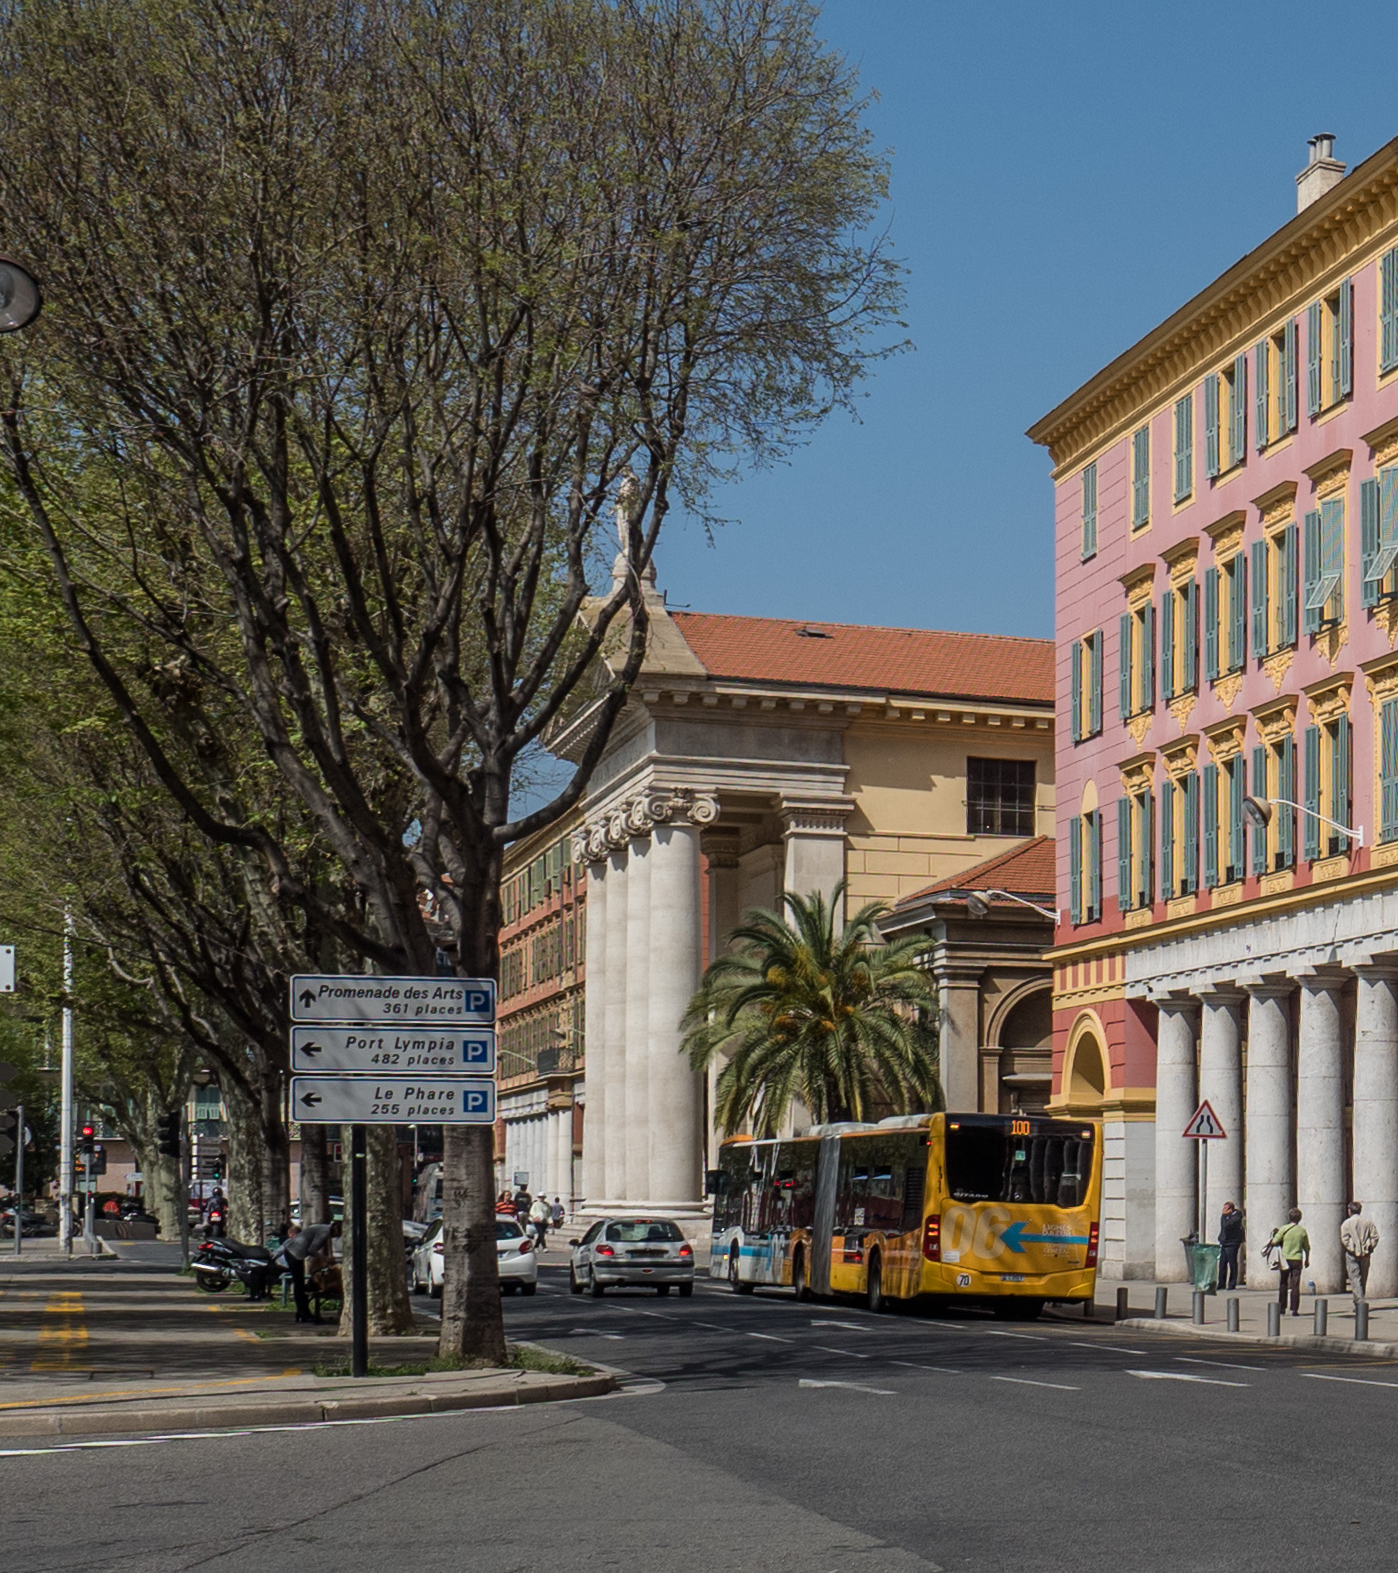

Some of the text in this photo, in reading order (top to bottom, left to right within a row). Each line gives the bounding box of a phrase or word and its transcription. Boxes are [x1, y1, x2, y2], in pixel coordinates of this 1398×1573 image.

[318, 984, 463, 1000] Promenade des Arts
[469, 992, 485, 1010] P
[382, 1003, 463, 1016] 361 places
[345, 1036, 456, 1052] Port Lympia
[467, 1043, 483, 1061] P
[371, 1054, 455, 1067] 482 places
[375, 1087, 455, 1100] Le Phare
[467, 1093, 483, 1111] P
[371, 1104, 455, 1117] 255 places
[1011, 1120, 1030, 1135] 100
[941, 1205, 1011, 1259] 06
[960, 1274, 970, 1287] 70
